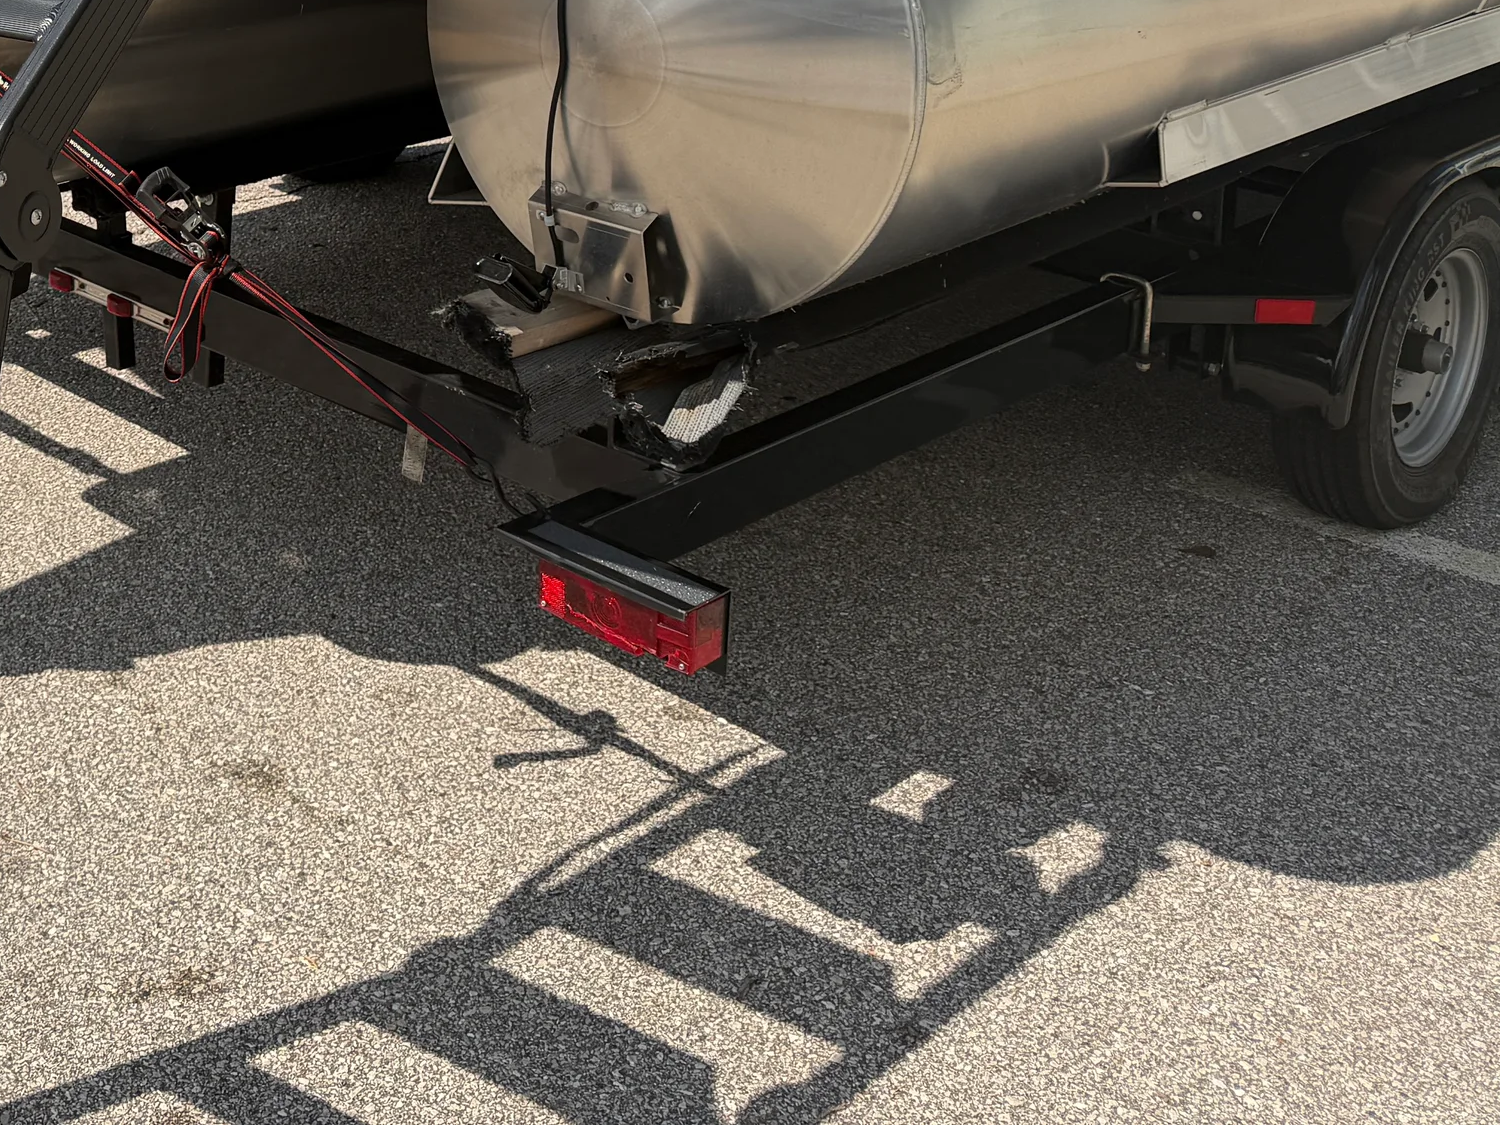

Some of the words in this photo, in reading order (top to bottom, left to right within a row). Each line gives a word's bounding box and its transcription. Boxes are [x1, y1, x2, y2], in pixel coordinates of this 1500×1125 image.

[69, 138, 91, 159] WORKING
[90, 156, 104, 169] LOAD
[102, 166, 116, 178] LIMIT
